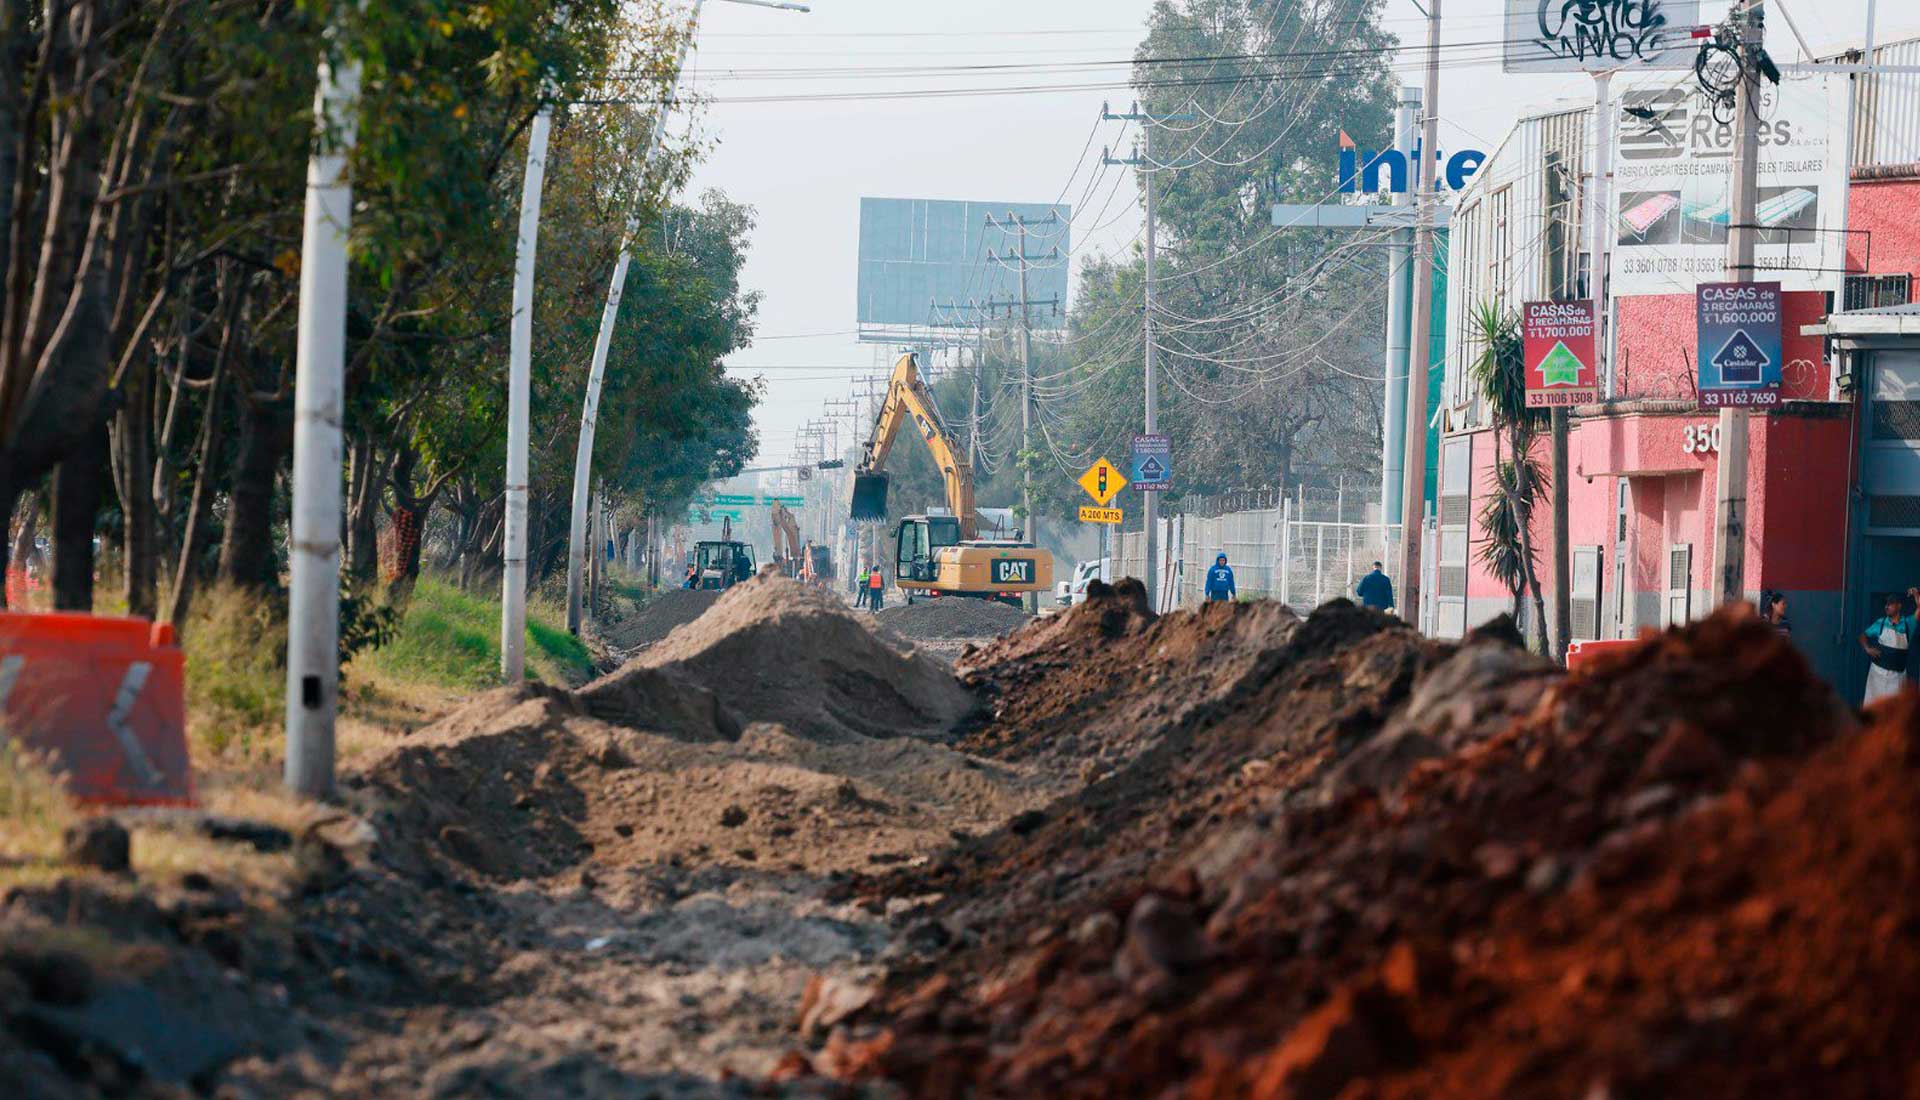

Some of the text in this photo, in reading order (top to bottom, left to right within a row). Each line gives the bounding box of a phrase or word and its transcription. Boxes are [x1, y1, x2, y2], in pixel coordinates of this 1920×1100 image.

[1691, 115, 1791, 148] Rees
[1618, 165, 1649, 177] FABRICA
[1779, 160, 1823, 173] TUBULARES
[1624, 259, 1633, 274] 33
[1702, 287, 1775, 300] CASAS de
[1530, 304, 1586, 317] CASAS de
[1703, 302, 1709, 312] 3
[1528, 318, 1534, 327] 3
[1531, 392, 1593, 405] 33 1106 1308
[1704, 392, 1776, 405] 33 1162 7650
[1081, 510, 1120, 520] A 200 MTS
[999, 561, 1028, 582] CAT
